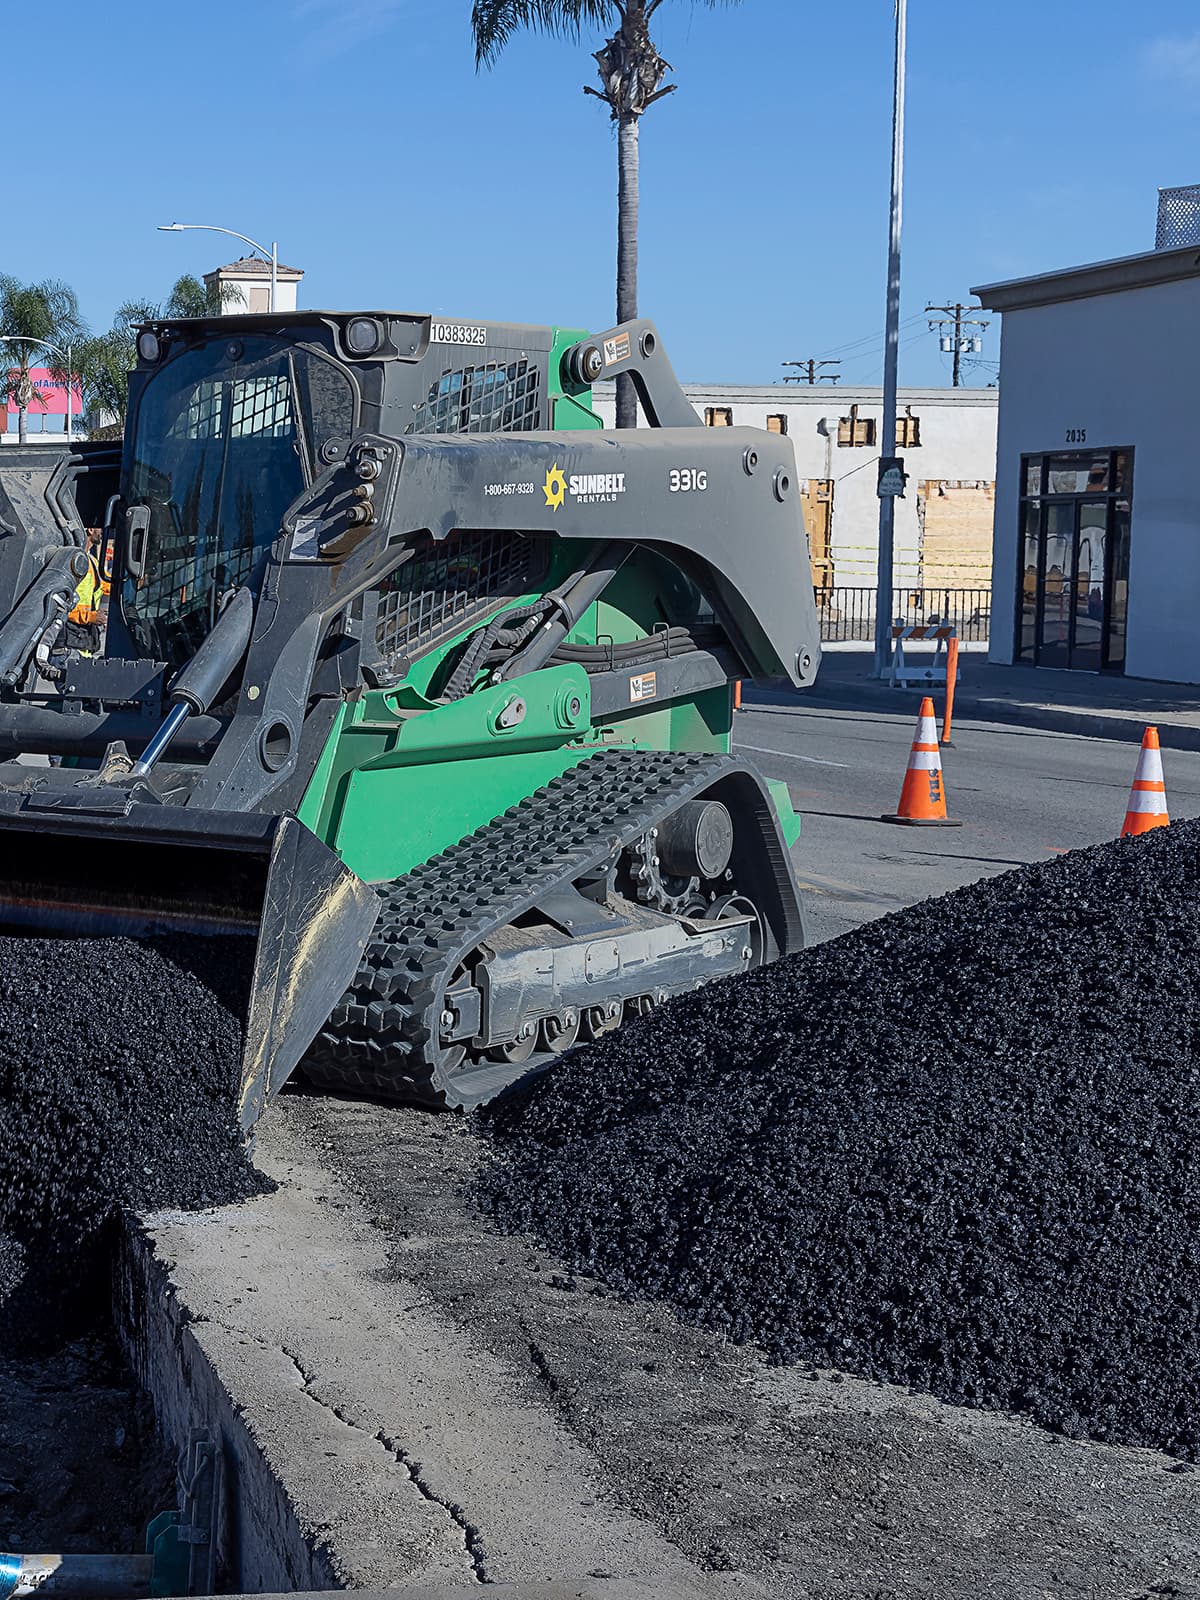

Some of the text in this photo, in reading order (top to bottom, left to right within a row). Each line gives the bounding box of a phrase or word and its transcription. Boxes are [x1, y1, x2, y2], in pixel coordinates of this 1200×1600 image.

[431, 324, 486, 345] 10383325
[33, 379, 42, 388] of
[1065, 429, 1087, 443] 2035
[569, 473, 626, 496] SUNBELT
[669, 468, 708, 493] 331G
[484, 482, 535, 496] 1-800-667-9328
[576, 494, 618, 504] RENTALS
